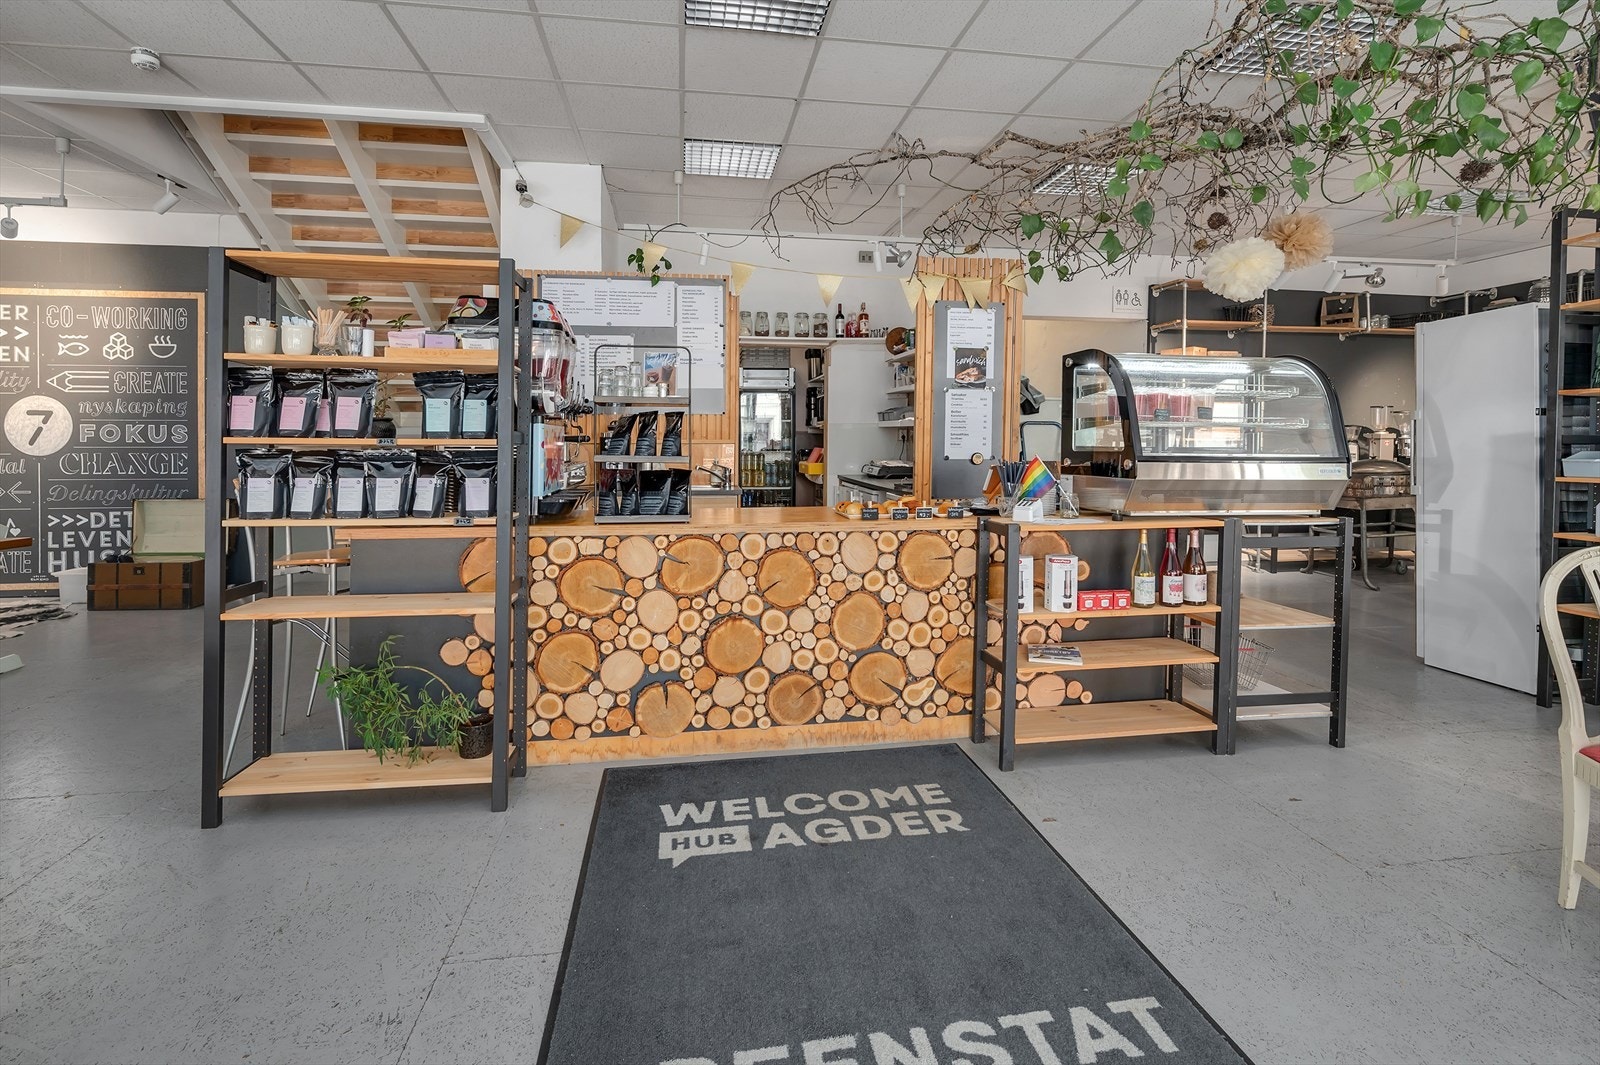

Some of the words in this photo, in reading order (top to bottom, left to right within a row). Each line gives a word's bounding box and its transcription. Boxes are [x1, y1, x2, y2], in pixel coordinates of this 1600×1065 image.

[46, 304, 188, 331] CO-WORKING
[113, 371, 188, 394] CREATE
[78, 398, 188, 418] nyskaping
[26, 409, 54, 447] 7
[79, 424, 188, 443] FOKUS
[59, 452, 189, 475] CHANGE
[47, 483, 190, 506] Delingskultur
[658, 782, 952, 827] WELCOME
[671, 833, 738, 851] HUB
[762, 808, 971, 850] AGDER
